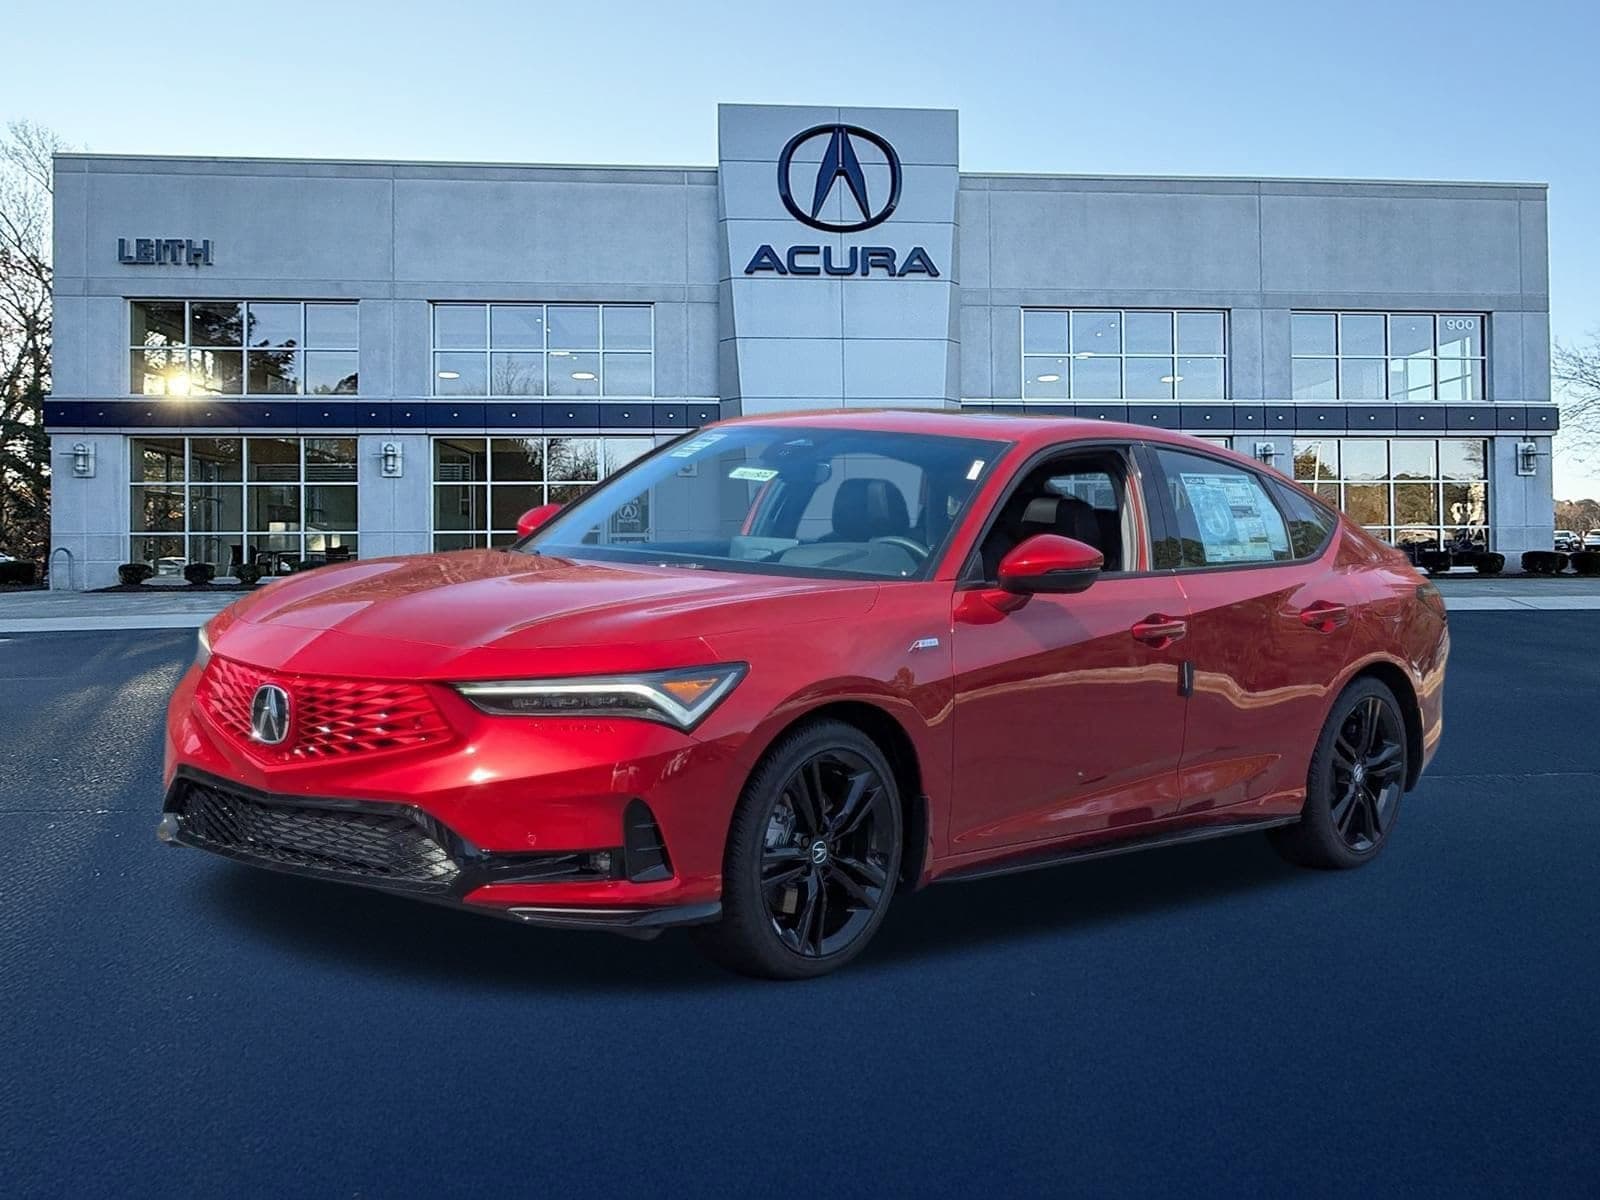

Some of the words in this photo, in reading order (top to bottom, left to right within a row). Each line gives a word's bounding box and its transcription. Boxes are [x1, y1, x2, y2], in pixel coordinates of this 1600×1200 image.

[118, 238, 214, 265] LEITH
[744, 244, 940, 277] ACURA
[1446, 319, 1474, 330] 900
